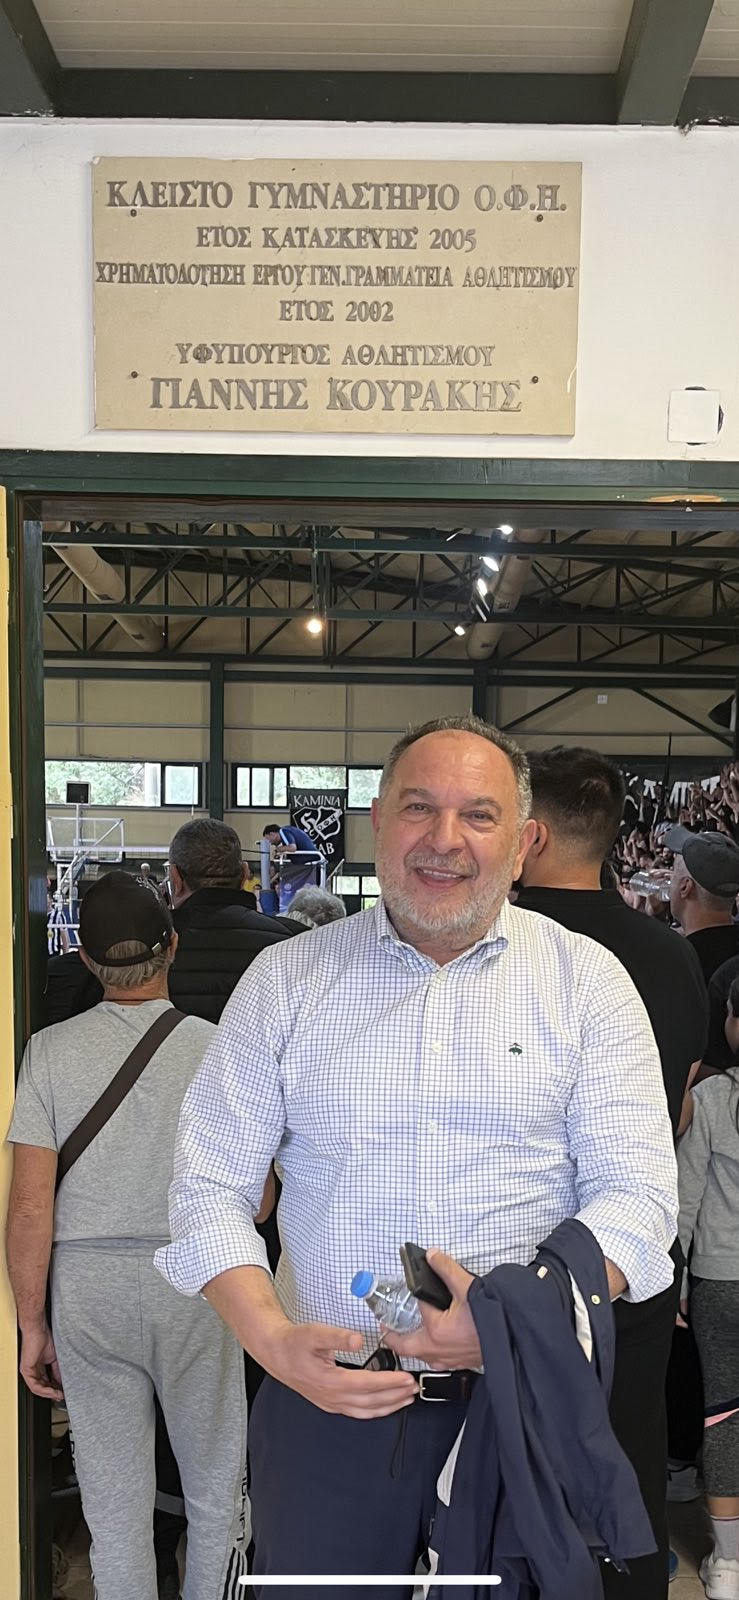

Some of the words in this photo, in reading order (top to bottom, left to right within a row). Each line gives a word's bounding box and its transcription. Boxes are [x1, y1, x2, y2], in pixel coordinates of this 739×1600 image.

[106, 180, 233, 210] ΚΛΕΙΣΤΟ
[248, 181, 460, 211] ΓΥΜΝΑΣΤΗΡΙΟ
[474, 184, 567, 212] Ο.Φ.Η.
[196, 226, 252, 248] ΕΤΟΣ
[262, 227, 418, 250] ΚΑΤΑΣΚΕΥΗΣ
[429, 228, 477, 253] 2005
[95, 262, 246, 286] ΧΡΗΜΑΤΟΔΟΤΗΣΗ
[462, 265, 577, 289] ΑΘΛΗΤΙΣΜΟΥ
[279, 299, 335, 322] ΕΤΟΣ
[345, 300, 394, 323] 2002
[175, 342, 330, 366] ΥΦΥΠΟΥΡΓΟΣ
[341, 344, 495, 367] ΑΘΛΗΤΙΣΜΟΥ
[149, 377, 308, 411] ΓΙΑΝΝΗΣ
[326, 377, 522, 412] ΚΟΥΡΑΚΗΣ
